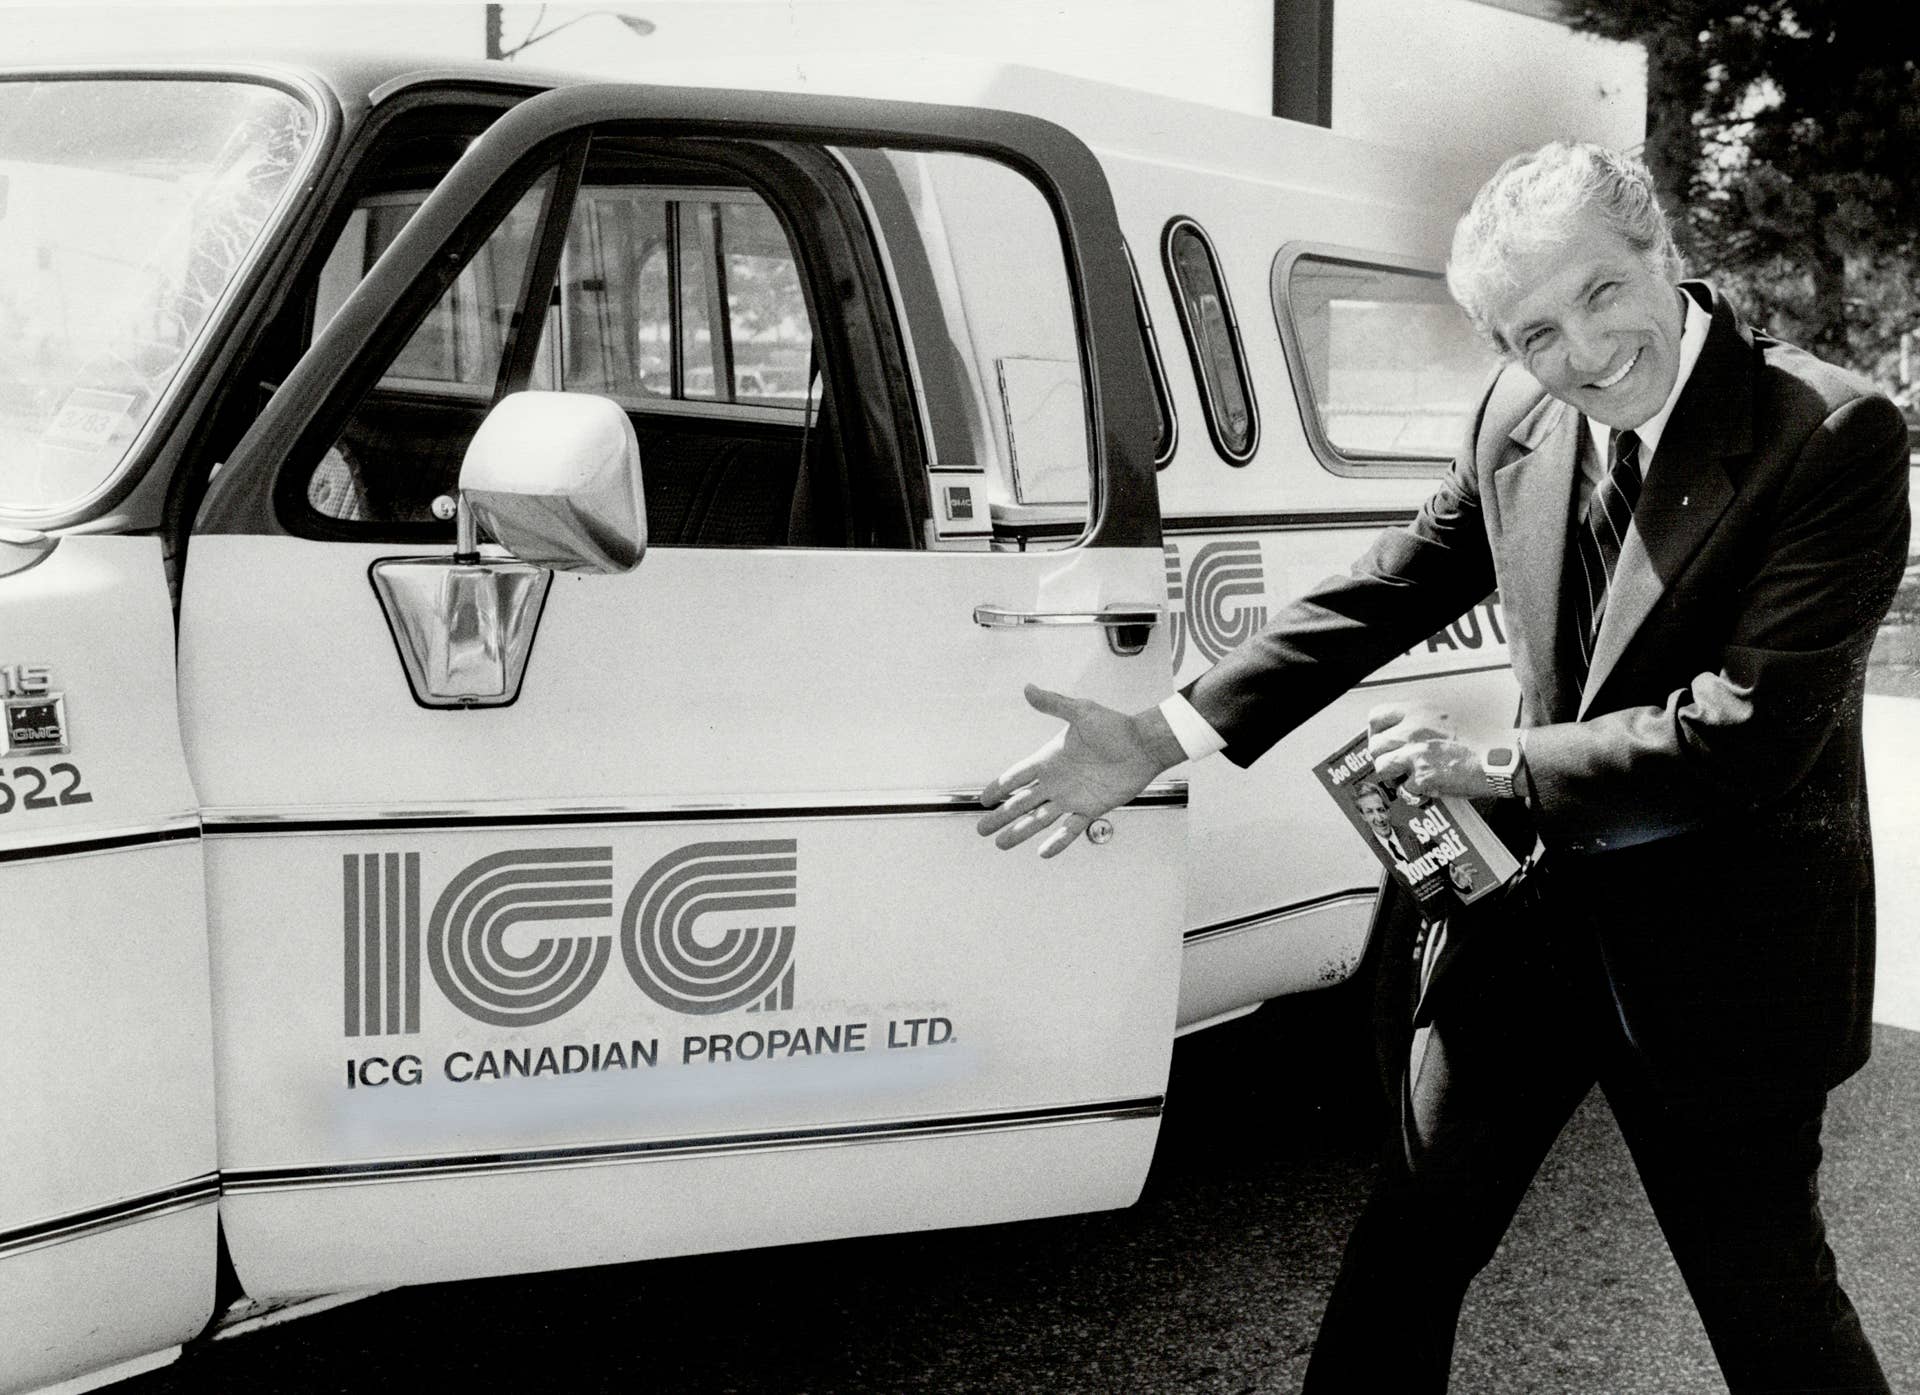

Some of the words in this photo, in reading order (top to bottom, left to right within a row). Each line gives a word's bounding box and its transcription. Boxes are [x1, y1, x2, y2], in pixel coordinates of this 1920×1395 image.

[12, 726, 62, 742] GMC
[1327, 764, 1351, 785] Joe
[1408, 805, 1451, 844] Sell
[1394, 828, 1469, 886] Yourself
[343, 838, 797, 1037] ICG
[347, 1054, 422, 1089] ICG
[443, 1039, 658, 1083] CANADIAN
[682, 1023, 866, 1064] PROPANE
[887, 1016, 957, 1050] LTD.
